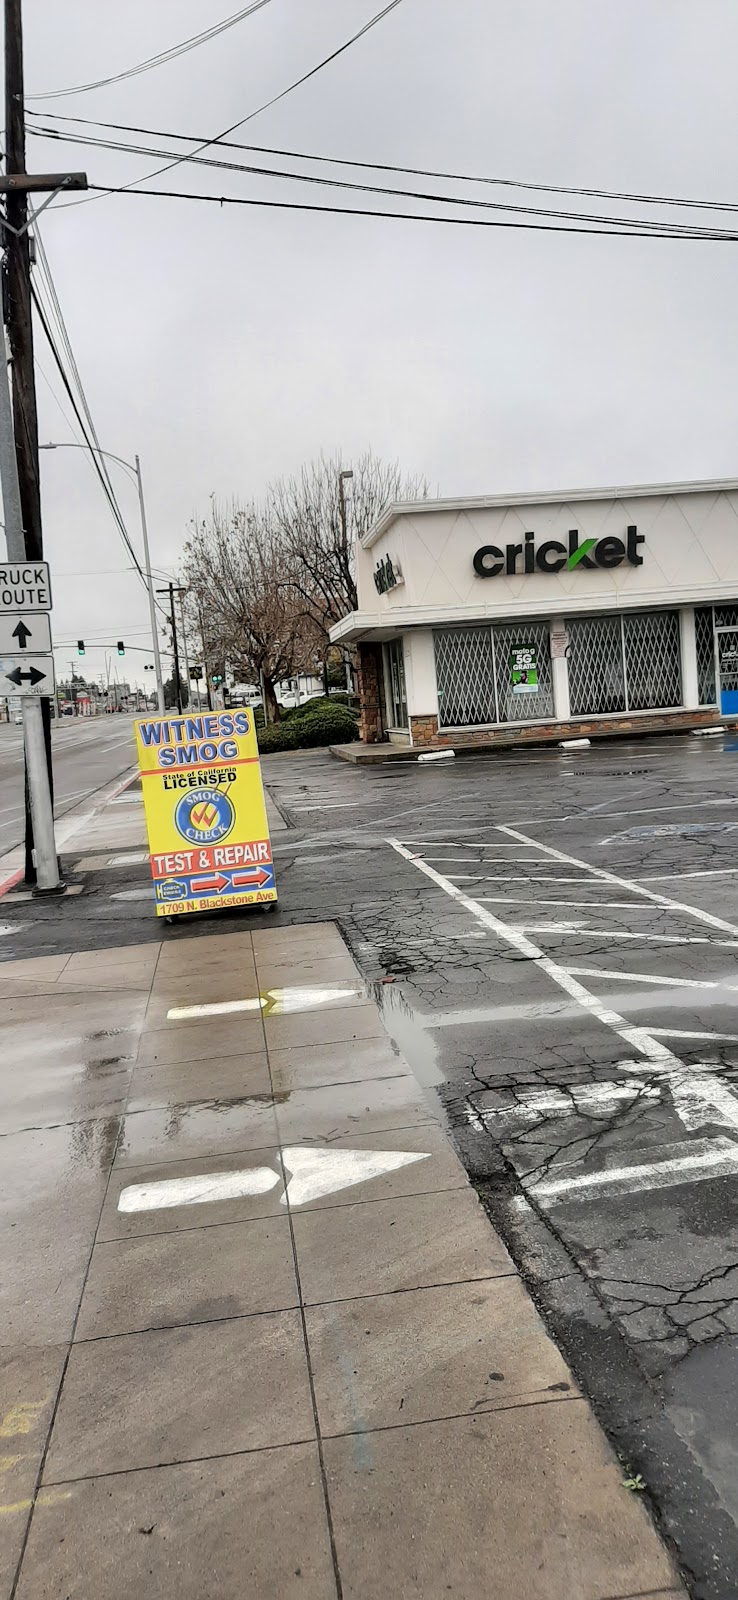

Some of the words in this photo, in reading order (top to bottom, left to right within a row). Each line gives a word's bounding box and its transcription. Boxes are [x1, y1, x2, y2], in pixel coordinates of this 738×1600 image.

[472, 525, 645, 578] cricket
[0, 569, 45, 586] RUCK
[0, 589, 48, 605] OUTE
[516, 654, 532, 664] 5G
[139, 711, 250, 747] WITNESS
[158, 740, 239, 767] SMOG
[162, 773, 184, 781] State
[186, 770, 195, 778] of
[197, 767, 237, 777] California
[164, 772, 237, 790] LICENSED
[186, 791, 221, 806] SMOG
[185, 825, 228, 841] CHECK
[154, 852, 194, 875] TEST
[199, 851, 211, 869] &
[214, 842, 270, 866] REPAIR
[160, 901, 184, 915] 1709
[186, 899, 198, 911] N.
[200, 891, 254, 909] Blackstone
[256, 892, 274, 902] Ave
